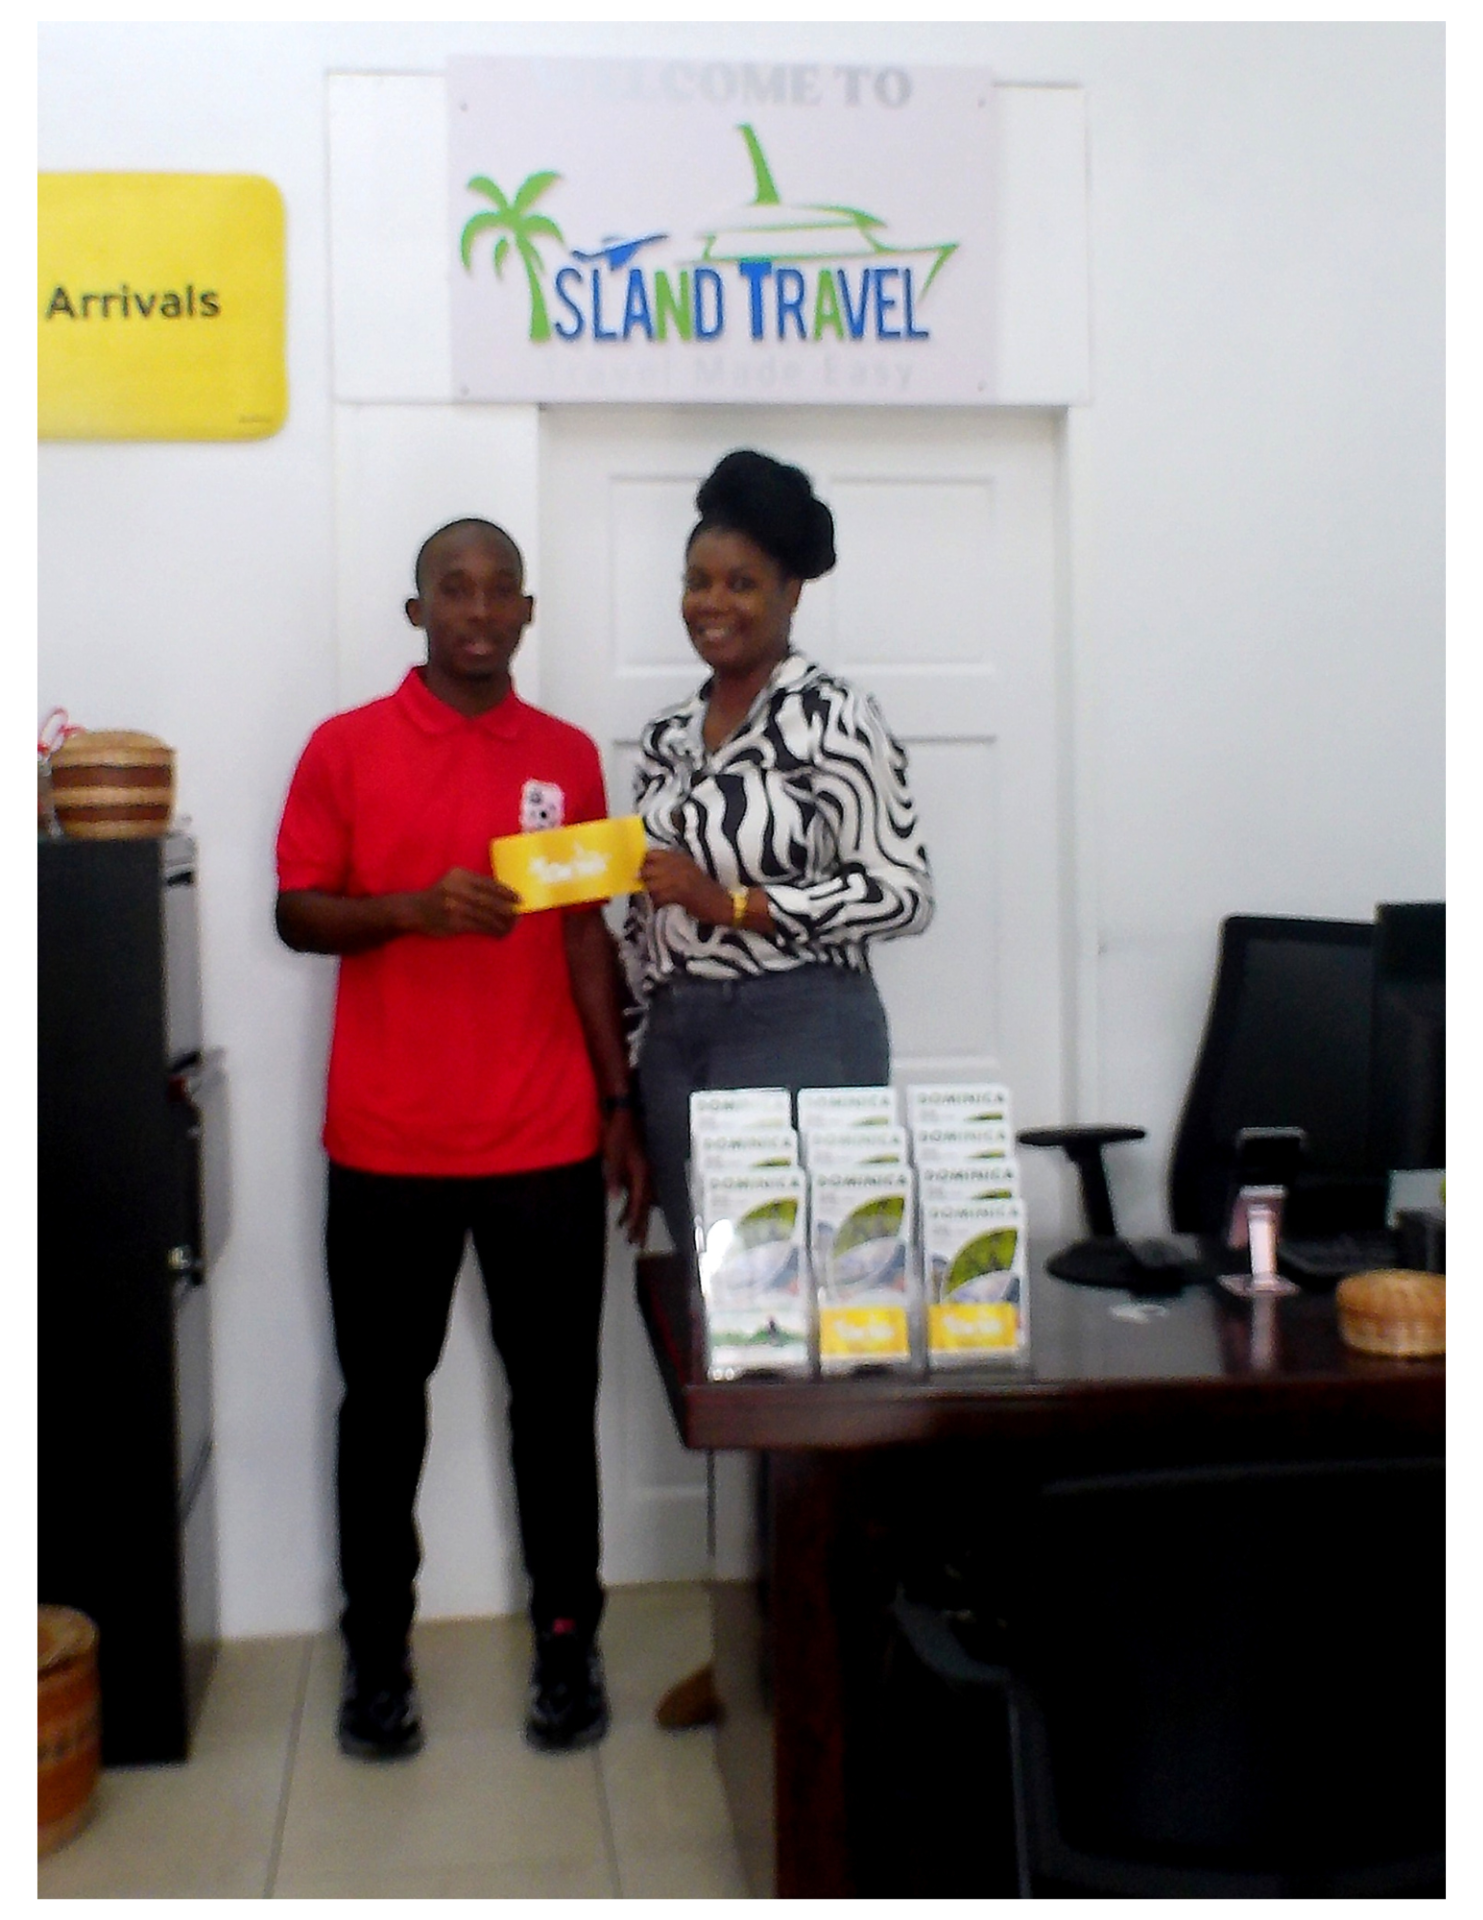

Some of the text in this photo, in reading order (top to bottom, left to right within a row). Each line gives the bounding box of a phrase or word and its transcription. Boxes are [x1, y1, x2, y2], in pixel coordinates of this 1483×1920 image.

[833, 64, 914, 109] TO
[45, 283, 222, 321] Arrivals
[740, 258, 930, 342] TRAVEL
